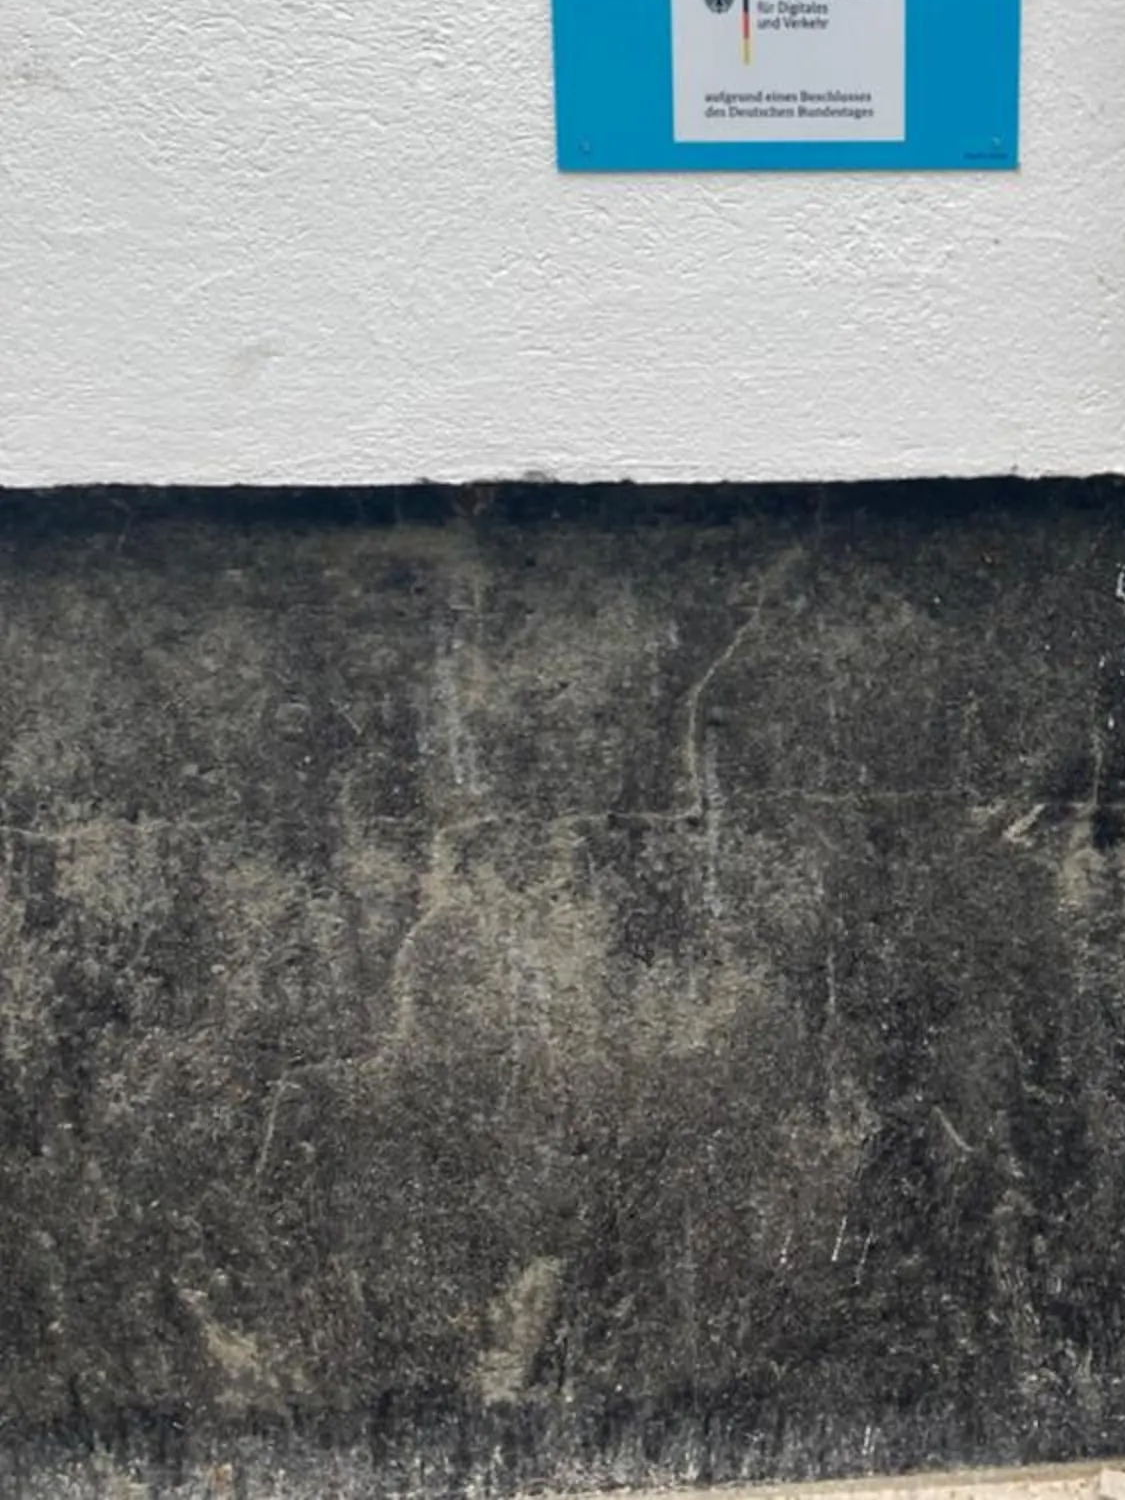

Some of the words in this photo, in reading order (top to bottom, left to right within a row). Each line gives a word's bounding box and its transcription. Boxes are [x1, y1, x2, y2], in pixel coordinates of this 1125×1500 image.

[758, 1, 775, 14] für
[778, 2, 828, 15] Digitales
[758, 17, 780, 29] und
[784, 18, 828, 29] Verkehr
[705, 92, 762, 104] aufgrund
[766, 92, 797, 102] eines
[800, 91, 872, 102] Beschlusses
[705, 107, 725, 118] des
[729, 107, 794, 118] Deutschen
[798, 107, 874, 119] Bundestages
